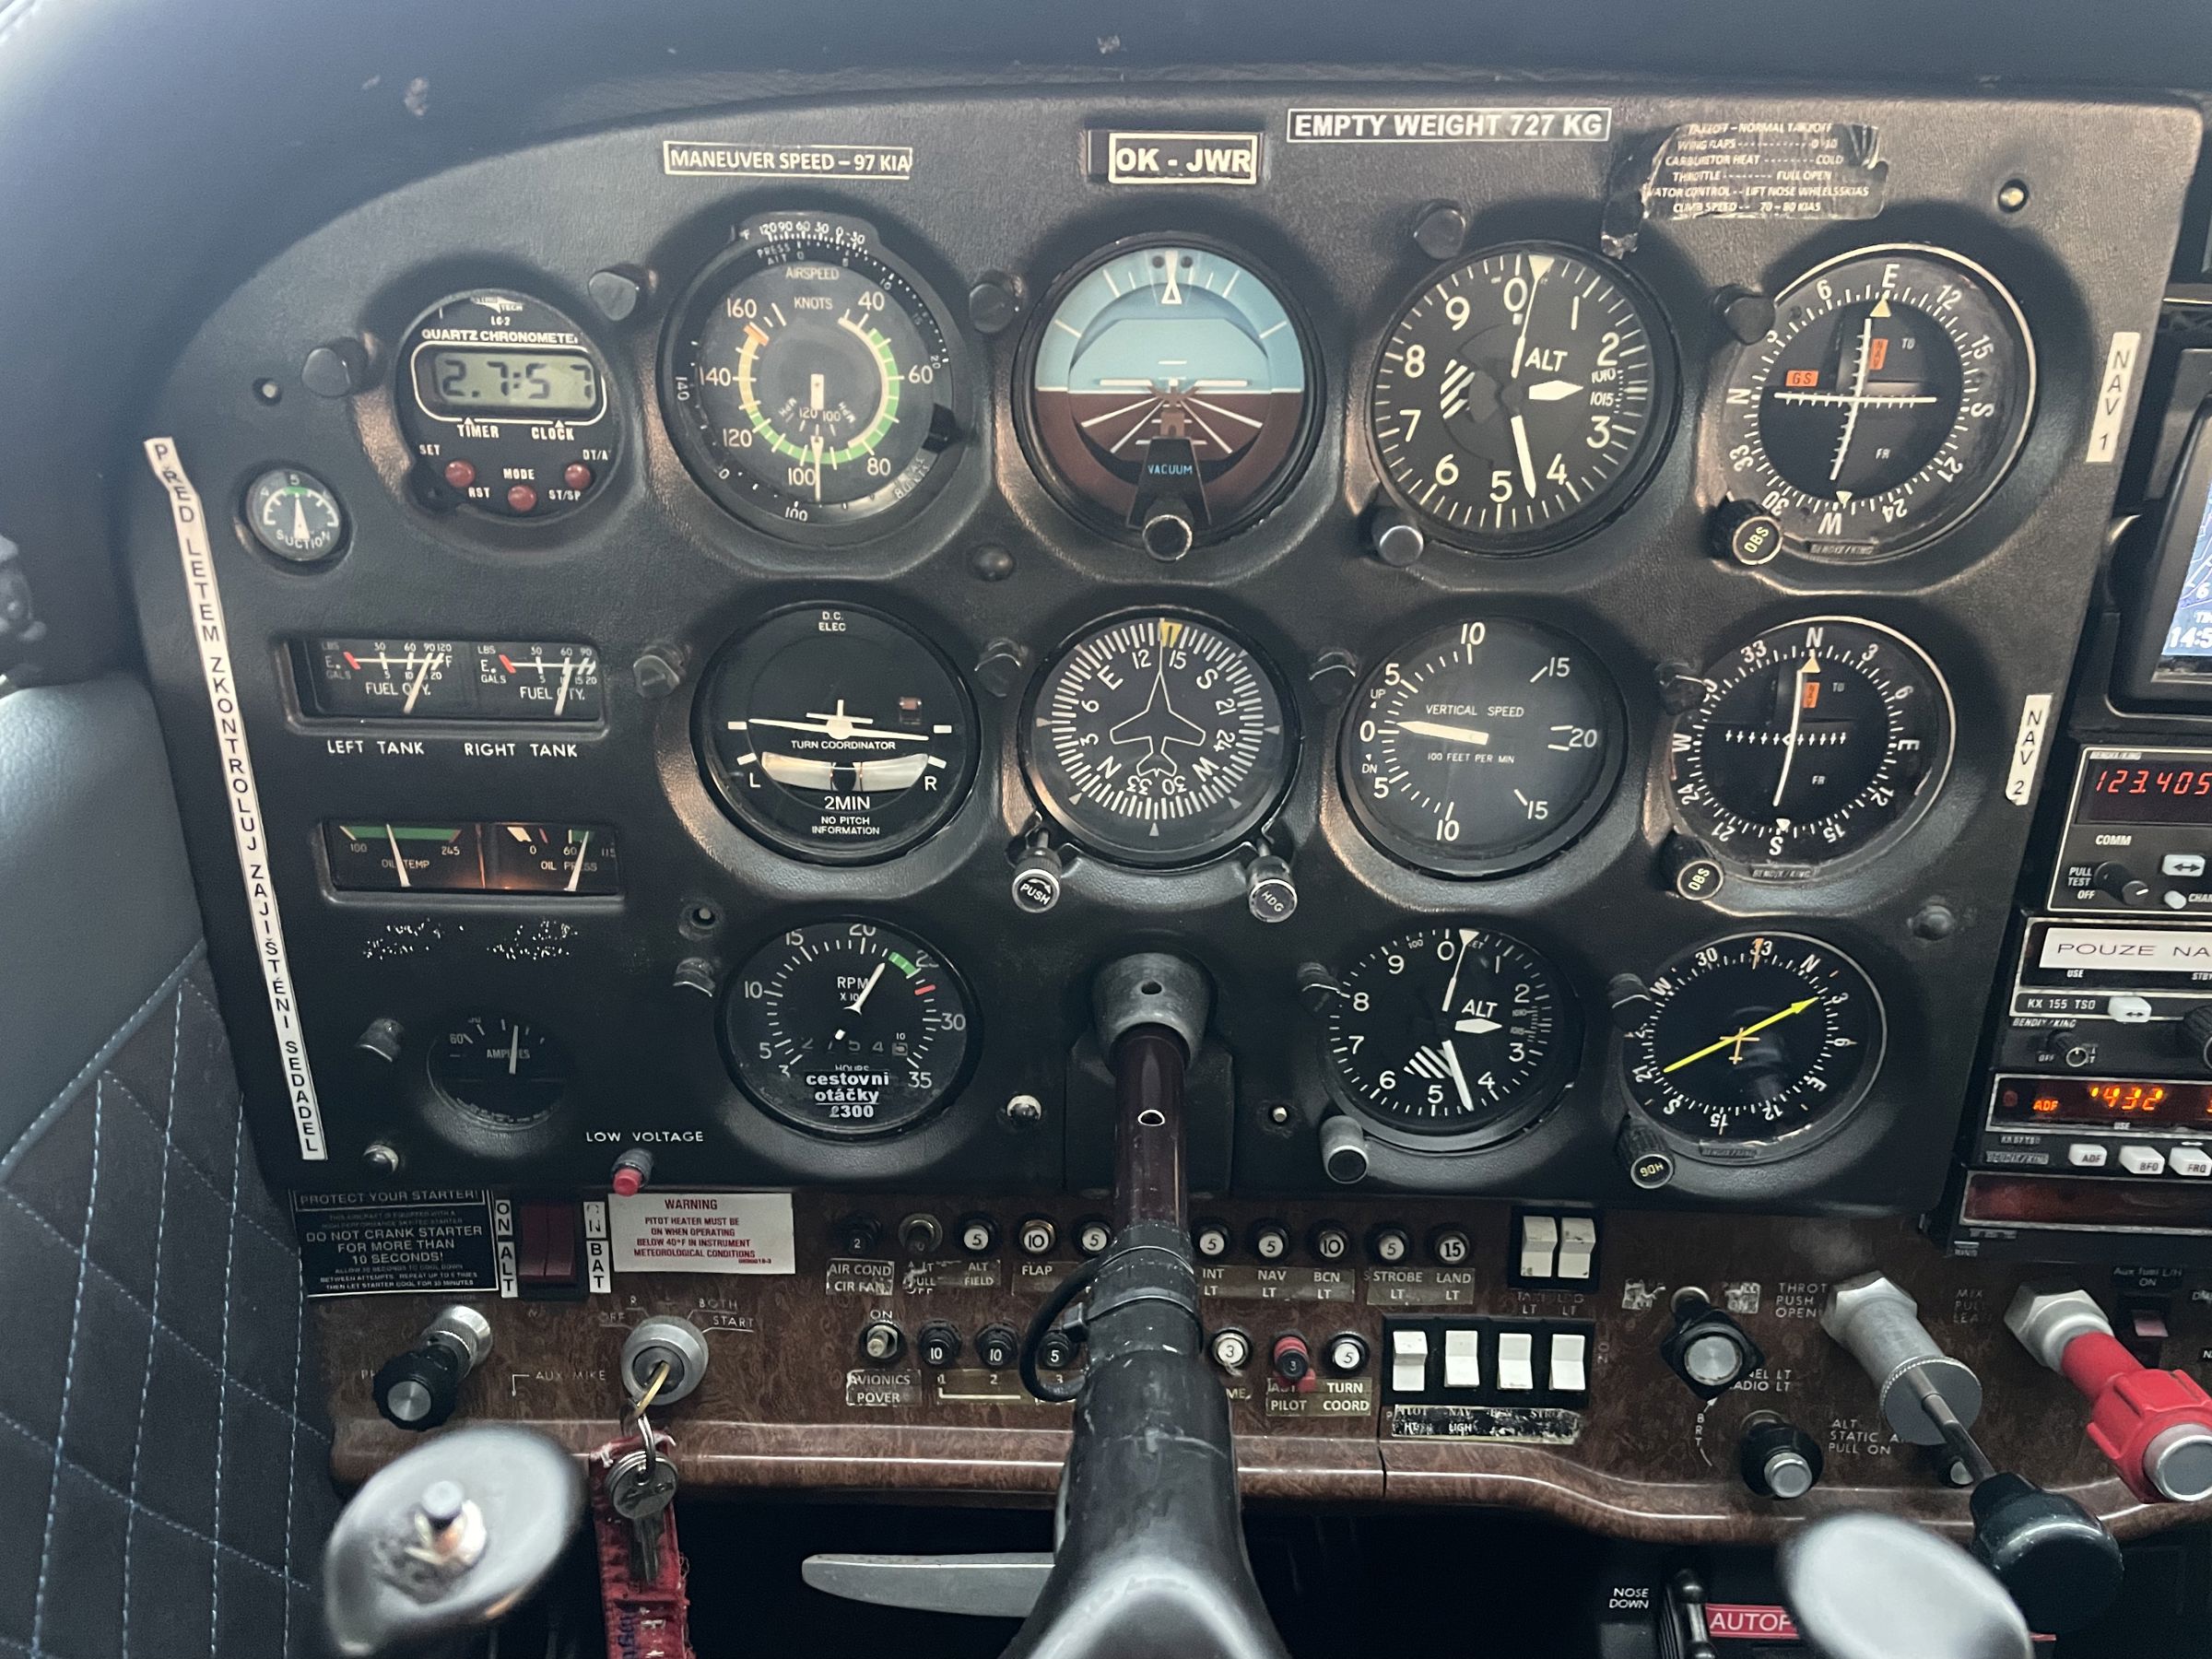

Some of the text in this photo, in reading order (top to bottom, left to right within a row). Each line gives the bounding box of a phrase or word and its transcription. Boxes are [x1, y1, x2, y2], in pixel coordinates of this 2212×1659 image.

[1294, 114, 1603, 136] EMPTY WEIGHT 727 KG
[670, 150, 775, 169] MANEUVER
[780, 153, 834, 170] SPEED
[854, 155, 875, 171] 97
[1115, 148, 1251, 173] OK JWR
[786, 268, 840, 279] AIRSPEED
[1882, 264, 1900, 288] E
[794, 297, 832, 310] KNOTS
[858, 291, 884, 311] 40
[726, 299, 757, 318] 160
[1445, 296, 1470, 331] 9
[422, 329, 477, 341] QUARTZ
[1597, 332, 1619, 366] 2
[1405, 345, 1425, 378] 8
[1524, 347, 1568, 371] ALT
[700, 368, 731, 386] 140
[908, 366, 933, 383] 60
[1590, 392, 1614, 406] 1015
[2100, 349, 2130, 450] NAV 1
[457, 425, 574, 441] TIMER CLOCK
[723, 429, 752, 447] 120
[1586, 416, 1610, 448] 3
[419, 445, 440, 454] SET
[503, 468, 535, 479] MODE
[867, 458, 890, 477] 80
[1147, 465, 1192, 475] VACUUM
[1436, 453, 1458, 486] 6
[1490, 471, 1512, 502] 5
[468, 488, 489, 498] RST
[548, 490, 581, 500] ST/SP
[1745, 527, 1770, 553] OBS
[818, 623, 845, 631] ELEC
[1461, 622, 1486, 644] 10
[1806, 628, 1823, 647] N
[1132, 650, 1151, 669] 12
[1169, 650, 1187, 669] 15
[1549, 657, 1570, 677] 15
[366, 683, 398, 695] FUEL
[520, 687, 553, 700] FUEL
[1371, 689, 1386, 699] UP
[1426, 704, 1524, 717] VERTICAL SPEED
[1569, 729, 1597, 747] 20
[327, 741, 424, 755] LEFT TANK
[465, 743, 578, 758] RIGHT TANK
[792, 740, 896, 750] TURN COORDINATOR
[1447, 753, 1469, 761] FEET
[1476, 754, 1493, 762] PER
[1498, 755, 1514, 763] MIN
[2014, 711, 2042, 794] NAV 2
[1362, 764, 1377, 773] DN
[749, 773, 761, 788] L
[924, 776, 937, 790] R
[825, 796, 870, 810] 2MIN
[840, 817, 869, 825] PITCH
[812, 826, 879, 835] INFORMATION
[2096, 835, 2132, 845] COMM
[541, 861, 557, 870] OIL
[2069, 867, 2091, 877] PULL
[1688, 868, 1710, 890] OBS
[2068, 877, 2090, 886] TEST
[1020, 884, 1050, 905] PUSH
[2077, 890, 2095, 900] OFF
[1262, 890, 1284, 912] HDG
[2058, 944, 2157, 956] POUZE
[1461, 999, 1498, 1018] ALT
[2028, 999, 2096, 1009] KX 155 TSO
[941, 1014, 966, 1030] 30
[908, 1072, 932, 1088] 35
[815, 1088, 879, 1104] otáčky
[2033, 1100, 2059, 1111] ADF
[586, 1132, 703, 1142] LOW VOLTAGE
[665, 1200, 717, 1209] WARNING
[307, 1226, 482, 1242] DO NOT CRANK STARTER
[338, 1239, 454, 1253] FOR MORE THAN
[1028, 1234, 1044, 1247] 10
[634, 1249, 704, 1257] METEOROLOGICAL
[1444, 1241, 1461, 1256] 15
[352, 1253, 443, 1265] 10 SECONDS!
[830, 1265, 891, 1276] AIR COND
[969, 1263, 987, 1271] ALT
[1022, 1265, 1052, 1276] FLAP
[1203, 1268, 1224, 1279] INT
[1258, 1269, 1286, 1280] NAV
[1313, 1271, 1340, 1283] BCN
[1373, 1271, 1422, 1283] STROBE
[1436, 1272, 1471, 1284] LAND
[835, 1281, 854, 1290] CIR
[965, 1277, 994, 1286] FIELD
[1317, 1288, 1332, 1300] LT
[1445, 1289, 1460, 1300] LT
[1777, 1296, 1814, 1306] PUSH
[1775, 1308, 1818, 1318] OPEN
[1327, 1382, 1363, 1394] TURN
[857, 1393, 900, 1404] POVER
[1271, 1399, 1307, 1411] PILOT
[1323, 1399, 1369, 1411] COORD
[1830, 1431, 1878, 1442] STATIC
[1829, 1442, 1890, 1454] PULL ON
[1614, 1588, 1649, 1598] NOSE
[1609, 1598, 1649, 1609] DOWN
